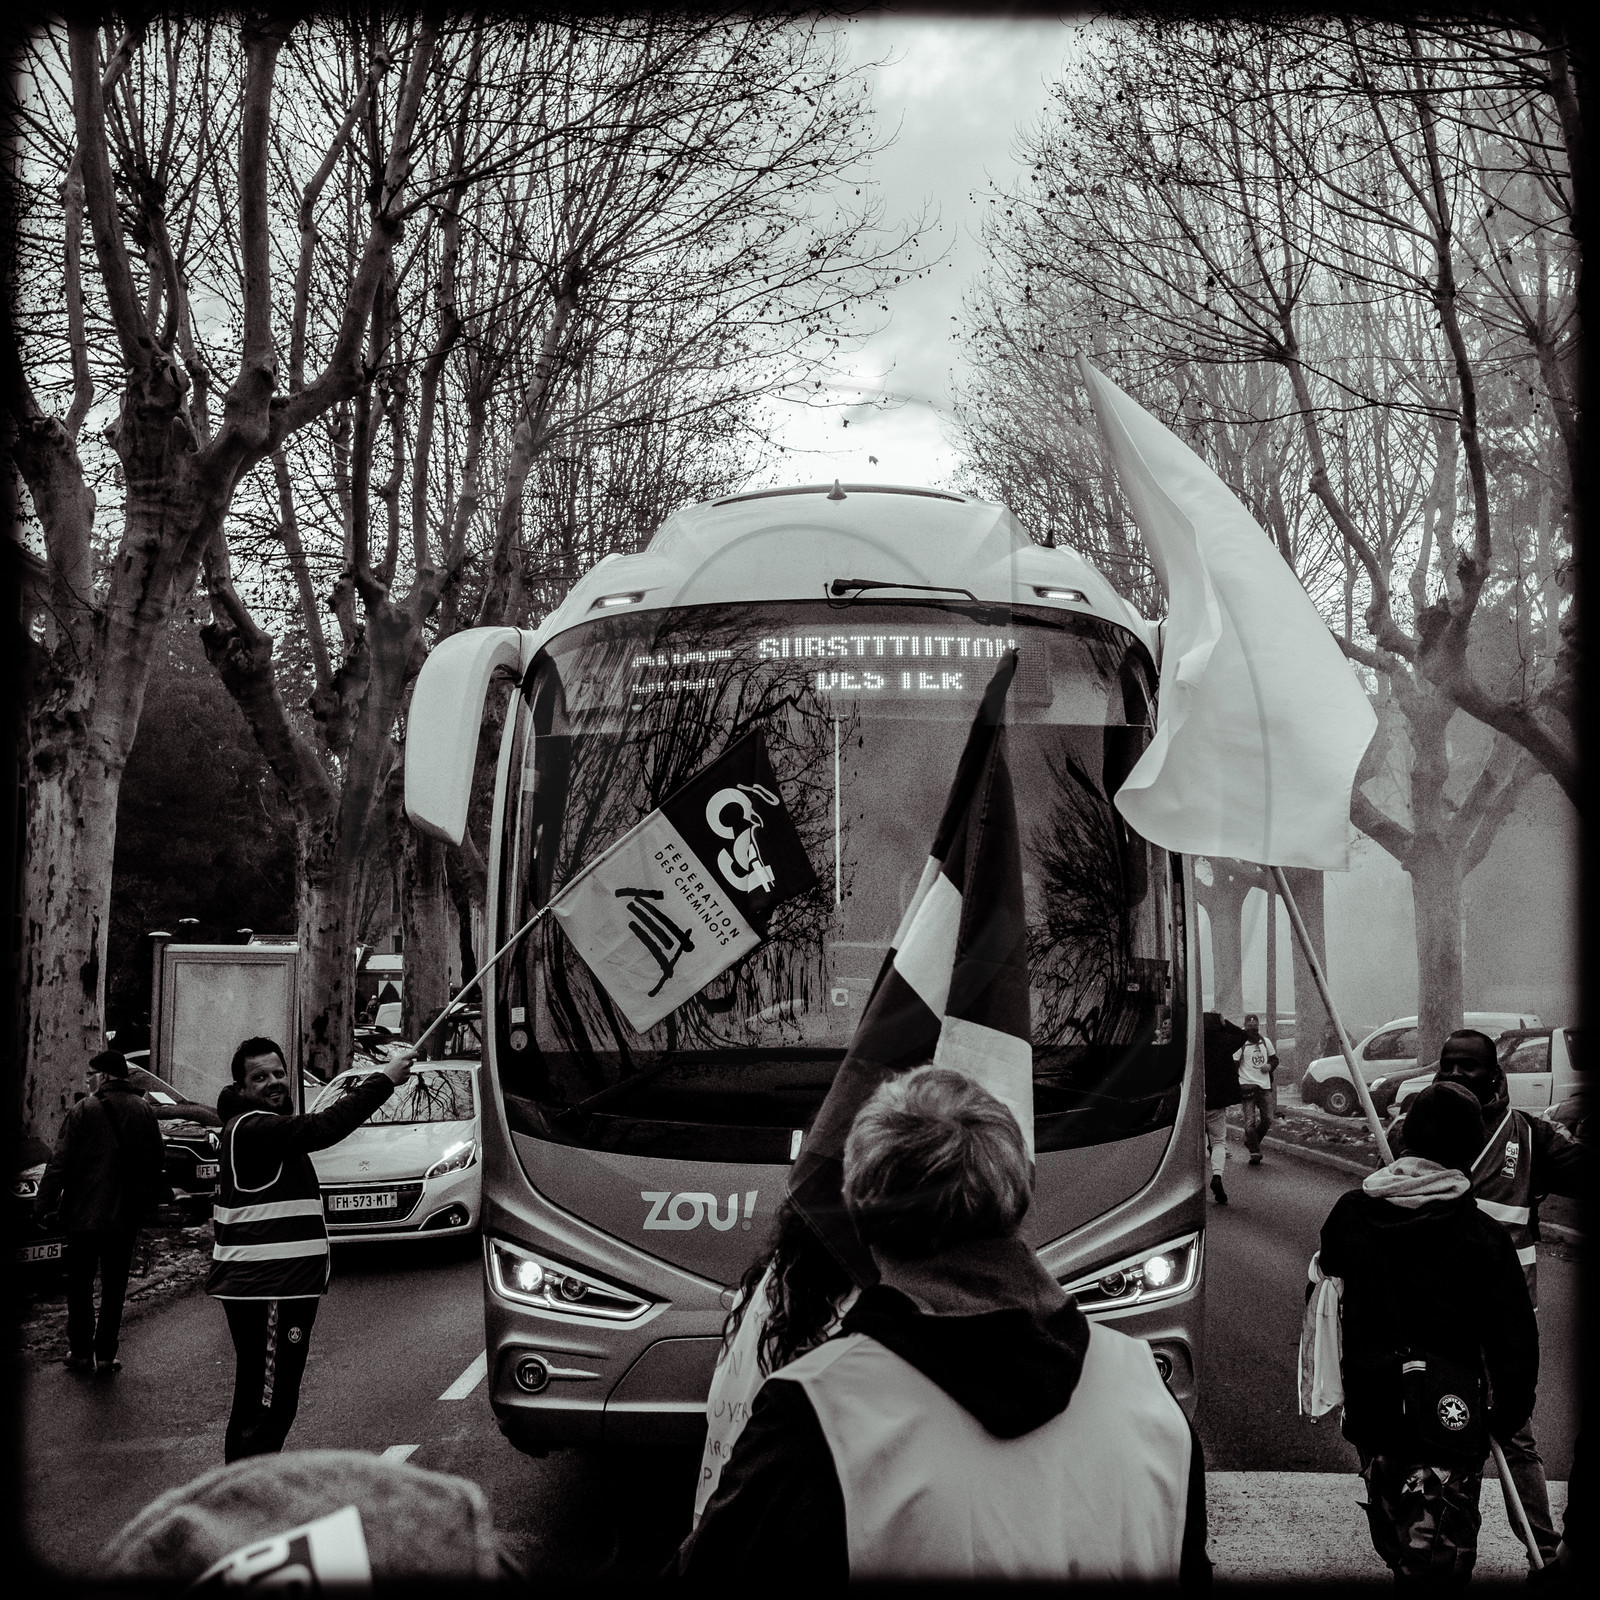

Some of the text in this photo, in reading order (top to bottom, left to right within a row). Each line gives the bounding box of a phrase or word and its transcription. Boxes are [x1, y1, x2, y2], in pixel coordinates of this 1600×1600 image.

[653, 851, 731, 947] DES CHEMINOTS
[663, 842, 740, 939] FÉDÉRATION
[336, 1194, 389, 1209] FH-573-MT
[640, 1189, 759, 1232] ZOU!
